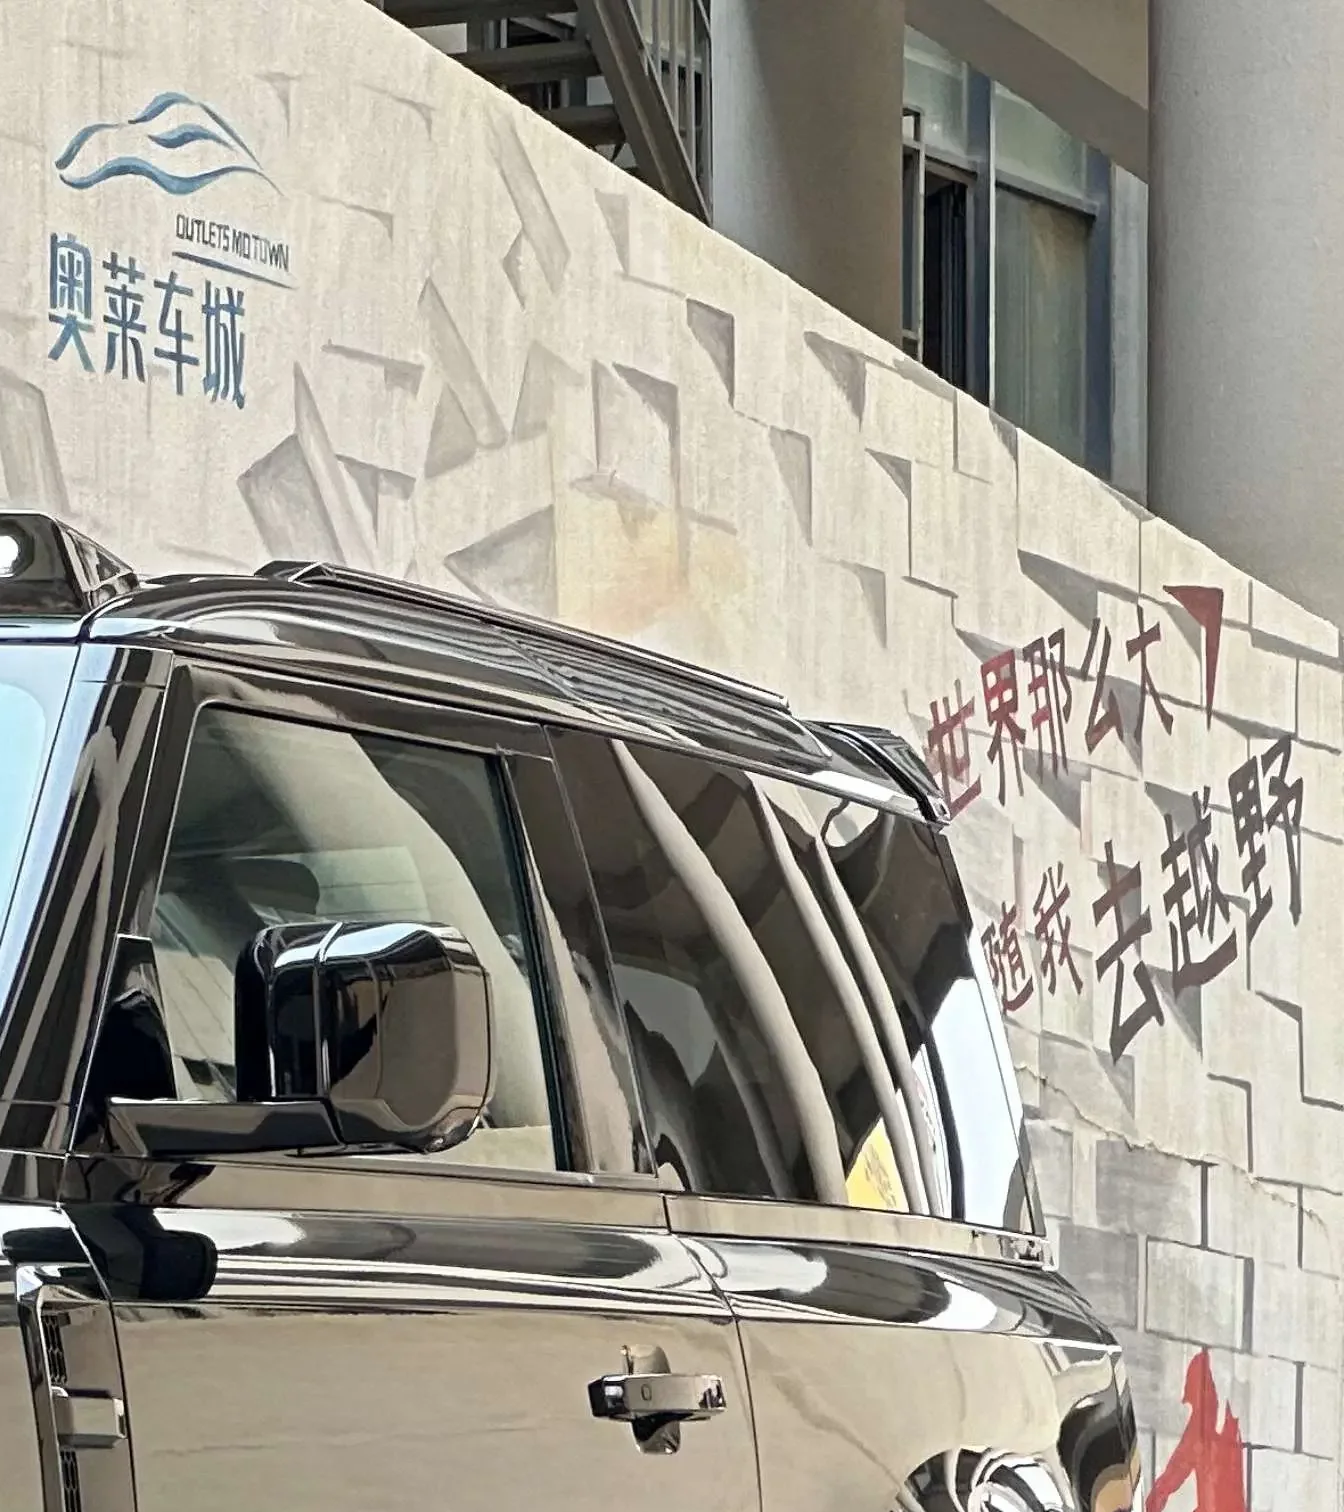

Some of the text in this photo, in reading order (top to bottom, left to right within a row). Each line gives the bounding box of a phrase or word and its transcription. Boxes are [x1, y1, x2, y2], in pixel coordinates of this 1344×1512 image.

[49, 232, 246, 409] 奥莱车城
[176, 214, 230, 252] OUTLETS
[924, 605, 1174, 820] 世界那么大
[981, 734, 1303, 1063] 随我去越野
